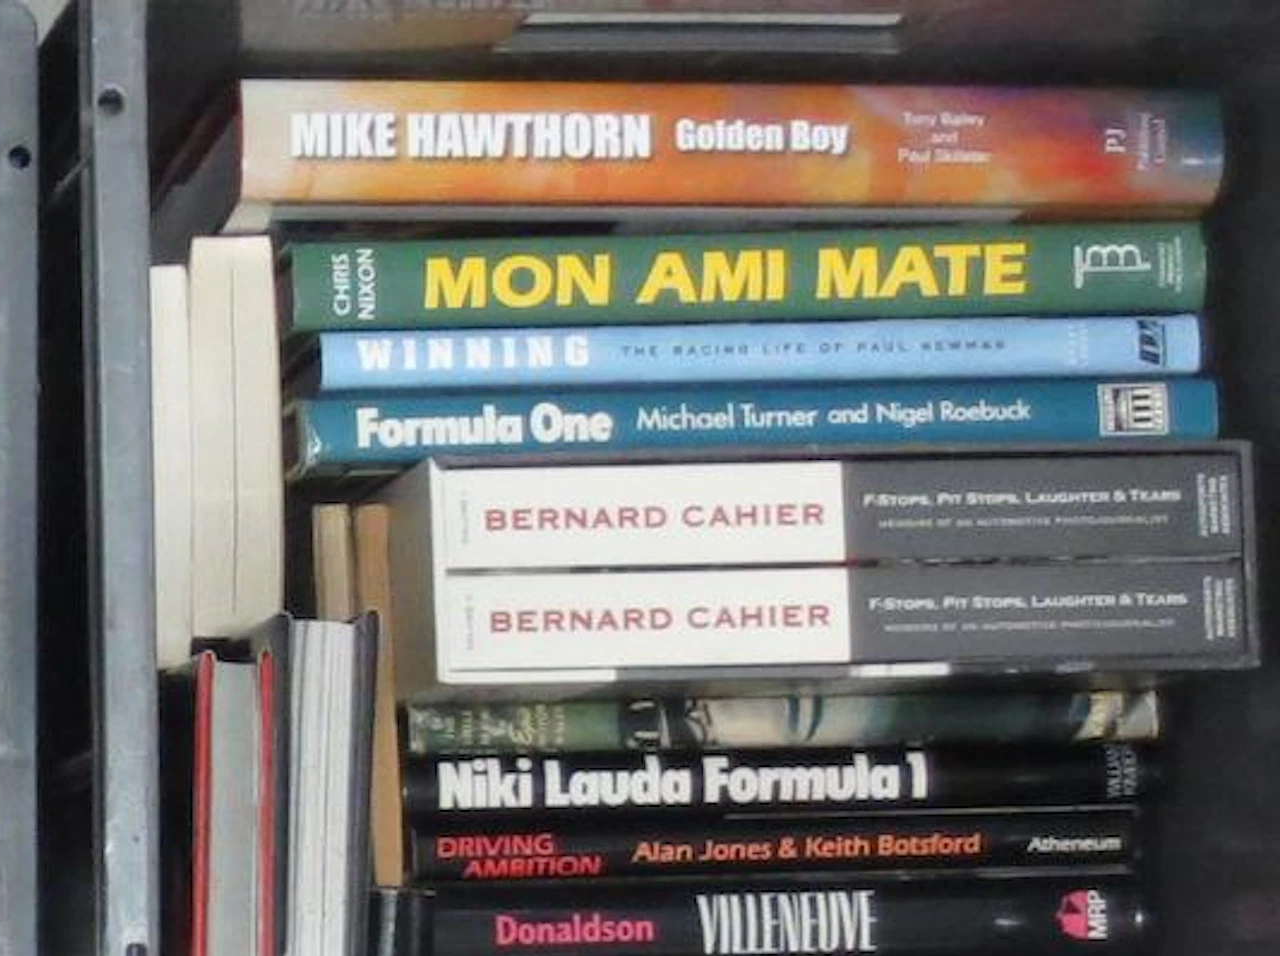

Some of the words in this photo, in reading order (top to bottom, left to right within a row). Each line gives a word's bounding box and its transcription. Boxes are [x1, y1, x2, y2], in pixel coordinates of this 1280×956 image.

[290, 112, 396, 158] MIKE
[407, 113, 652, 159] HAWTHORN
[675, 119, 783, 152] Golden
[790, 121, 848, 156] Boy
[333, 253, 351, 316] CHRIS
[358, 248, 376, 320] NIXON
[425, 253, 610, 308] MON
[636, 248, 787, 302] AMI
[815, 241, 1029, 298] MATE
[357, 335, 591, 369] WINNING
[357, 406, 523, 447] Formula
[529, 406, 614, 442] One
[637, 405, 734, 430] Michael
[739, 404, 818, 429] Turner
[827, 406, 869, 425] and
[875, 404, 934, 429] Nigel
[940, 398, 1032, 423] Roebuck
[484, 507, 668, 531] BERNARD
[682, 504, 826, 526] CAHIER
[439, 757, 533, 810] Niki
[545, 757, 692, 806] Lauda
[702, 752, 900, 803] Formula
[906, 751, 929, 799] 1
[632, 842, 693, 863] Alan
[698, 840, 771, 861] Jones
[778, 838, 797, 859] &
[805, 836, 870, 858] Keith
[877, 833, 981, 856] Botsford
[495, 914, 655, 945] Donaldson
[697, 890, 878, 955] VILLENEUVE
